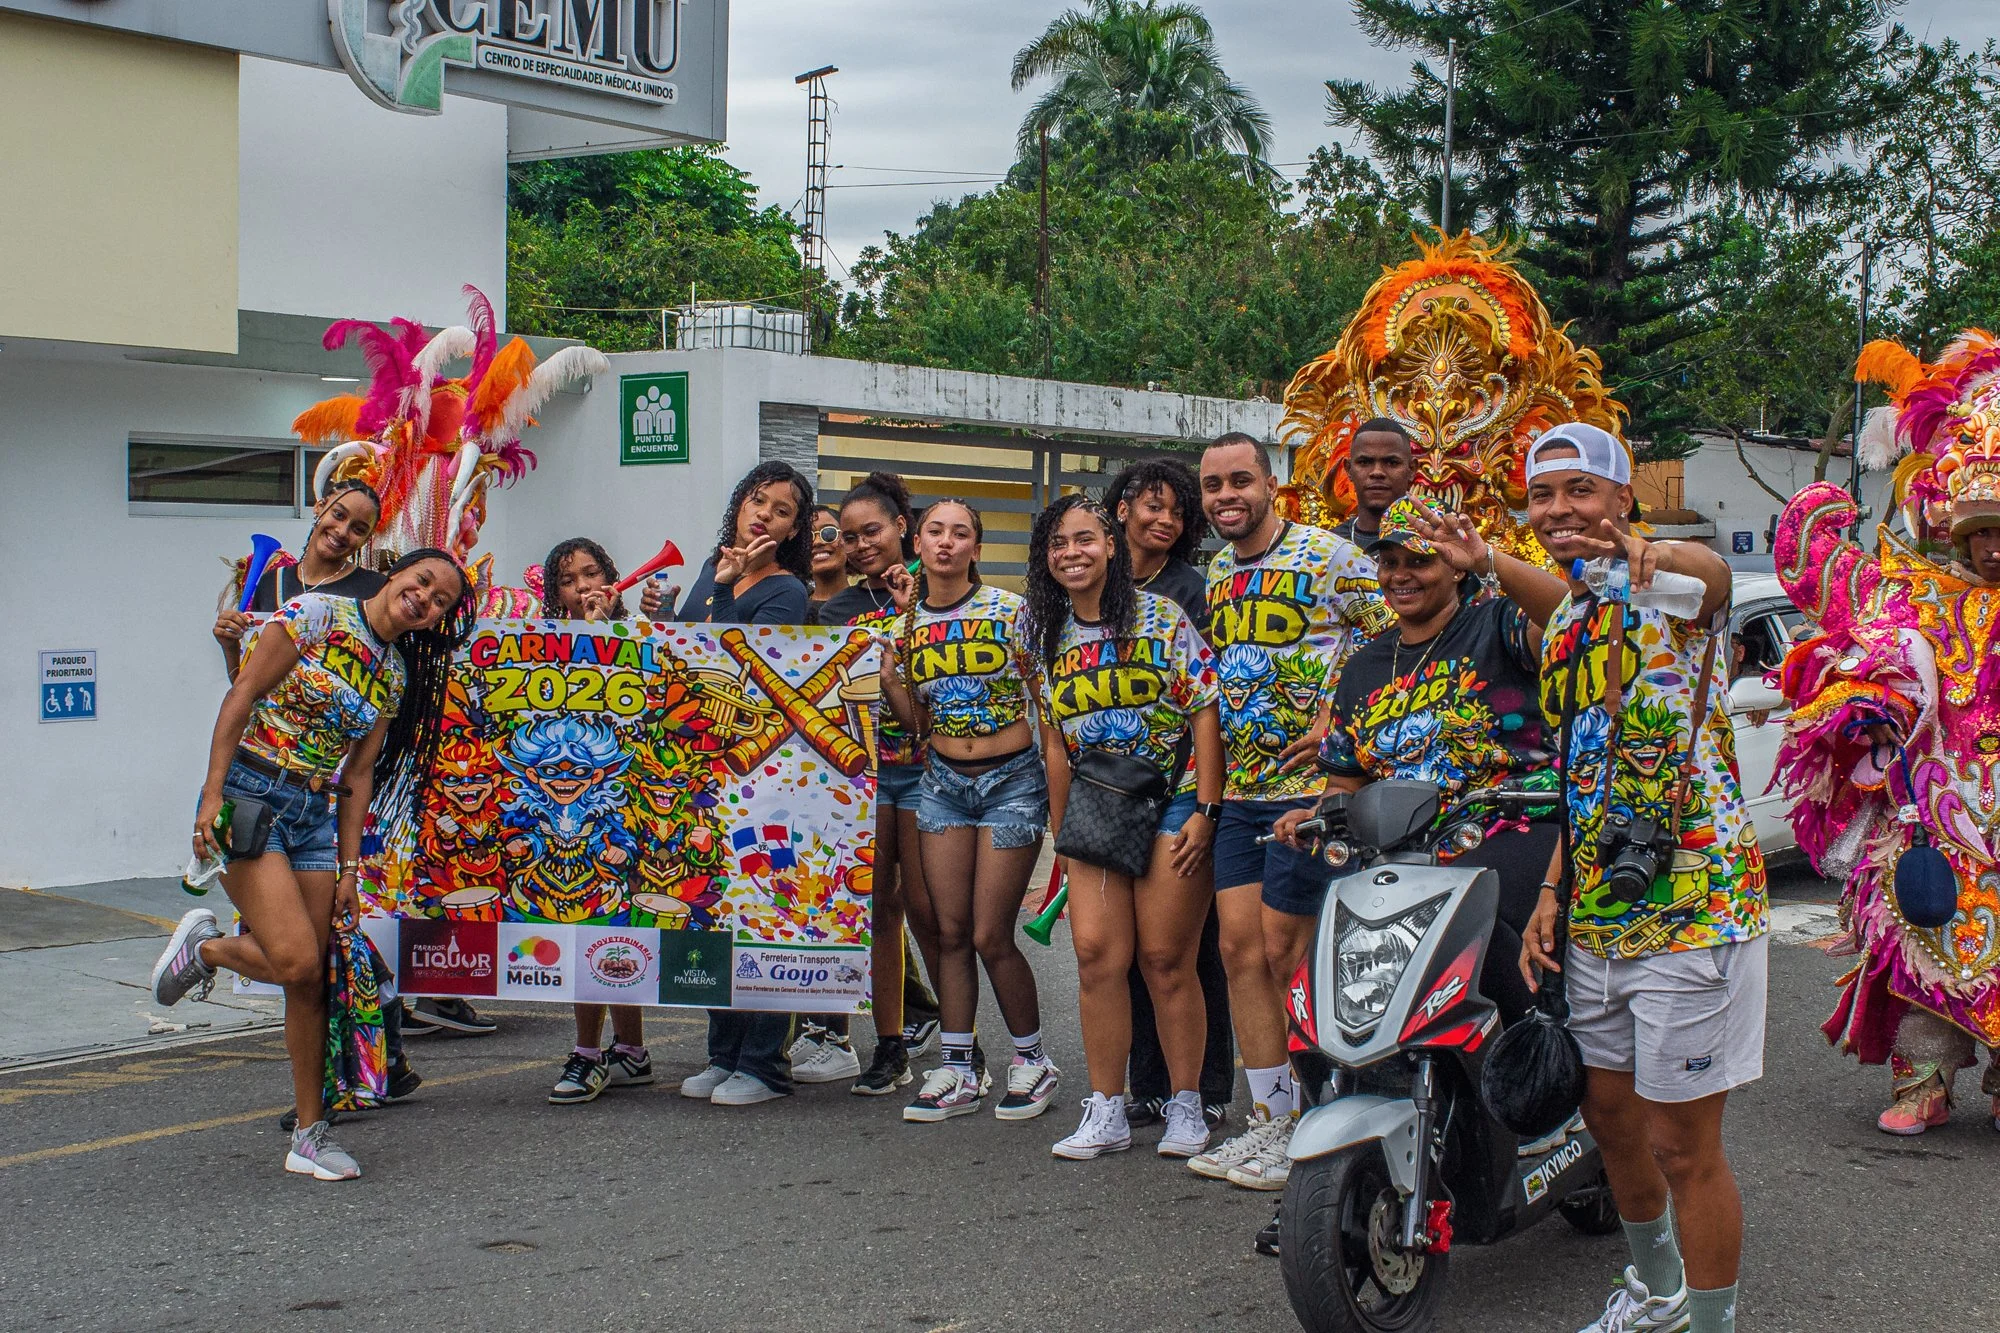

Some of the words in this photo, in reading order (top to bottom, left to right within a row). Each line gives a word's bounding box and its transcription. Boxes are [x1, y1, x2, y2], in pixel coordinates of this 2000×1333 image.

[484, 51, 521, 68] CENTRO
[522, 59, 534, 71] DE
[536, 61, 603, 85] ESPECIALIDADES
[604, 73, 642, 94] MÉDICAS
[643, 82, 674, 100] UNIDOS
[631, 444, 679, 453] ENCUENTRO
[635, 435, 662, 443] PUNTO
[663, 434, 674, 442] DE
[1210, 571, 1313, 609] ARNAVAL
[52, 656, 87, 665] PARQUEO
[470, 633, 662, 673] CARNAVAL
[1052, 638, 1168, 677] ARNAVAL
[46, 668, 93, 677] PRIORITARIO
[481, 667, 646, 714] 2026
[1365, 678, 1449, 728] 2026
[412, 946, 491, 969] LIQUOR
[584, 936, 653, 961] AGROVETERINARIA
[799, 954, 841, 965] Transporte
[507, 971, 562, 986] Melba
[674, 976, 717, 985] PALMERAS
[683, 969, 707, 977] VISTA
[770, 964, 829, 986] Goyo
[1541, 1140, 1582, 1181] KYMCO
